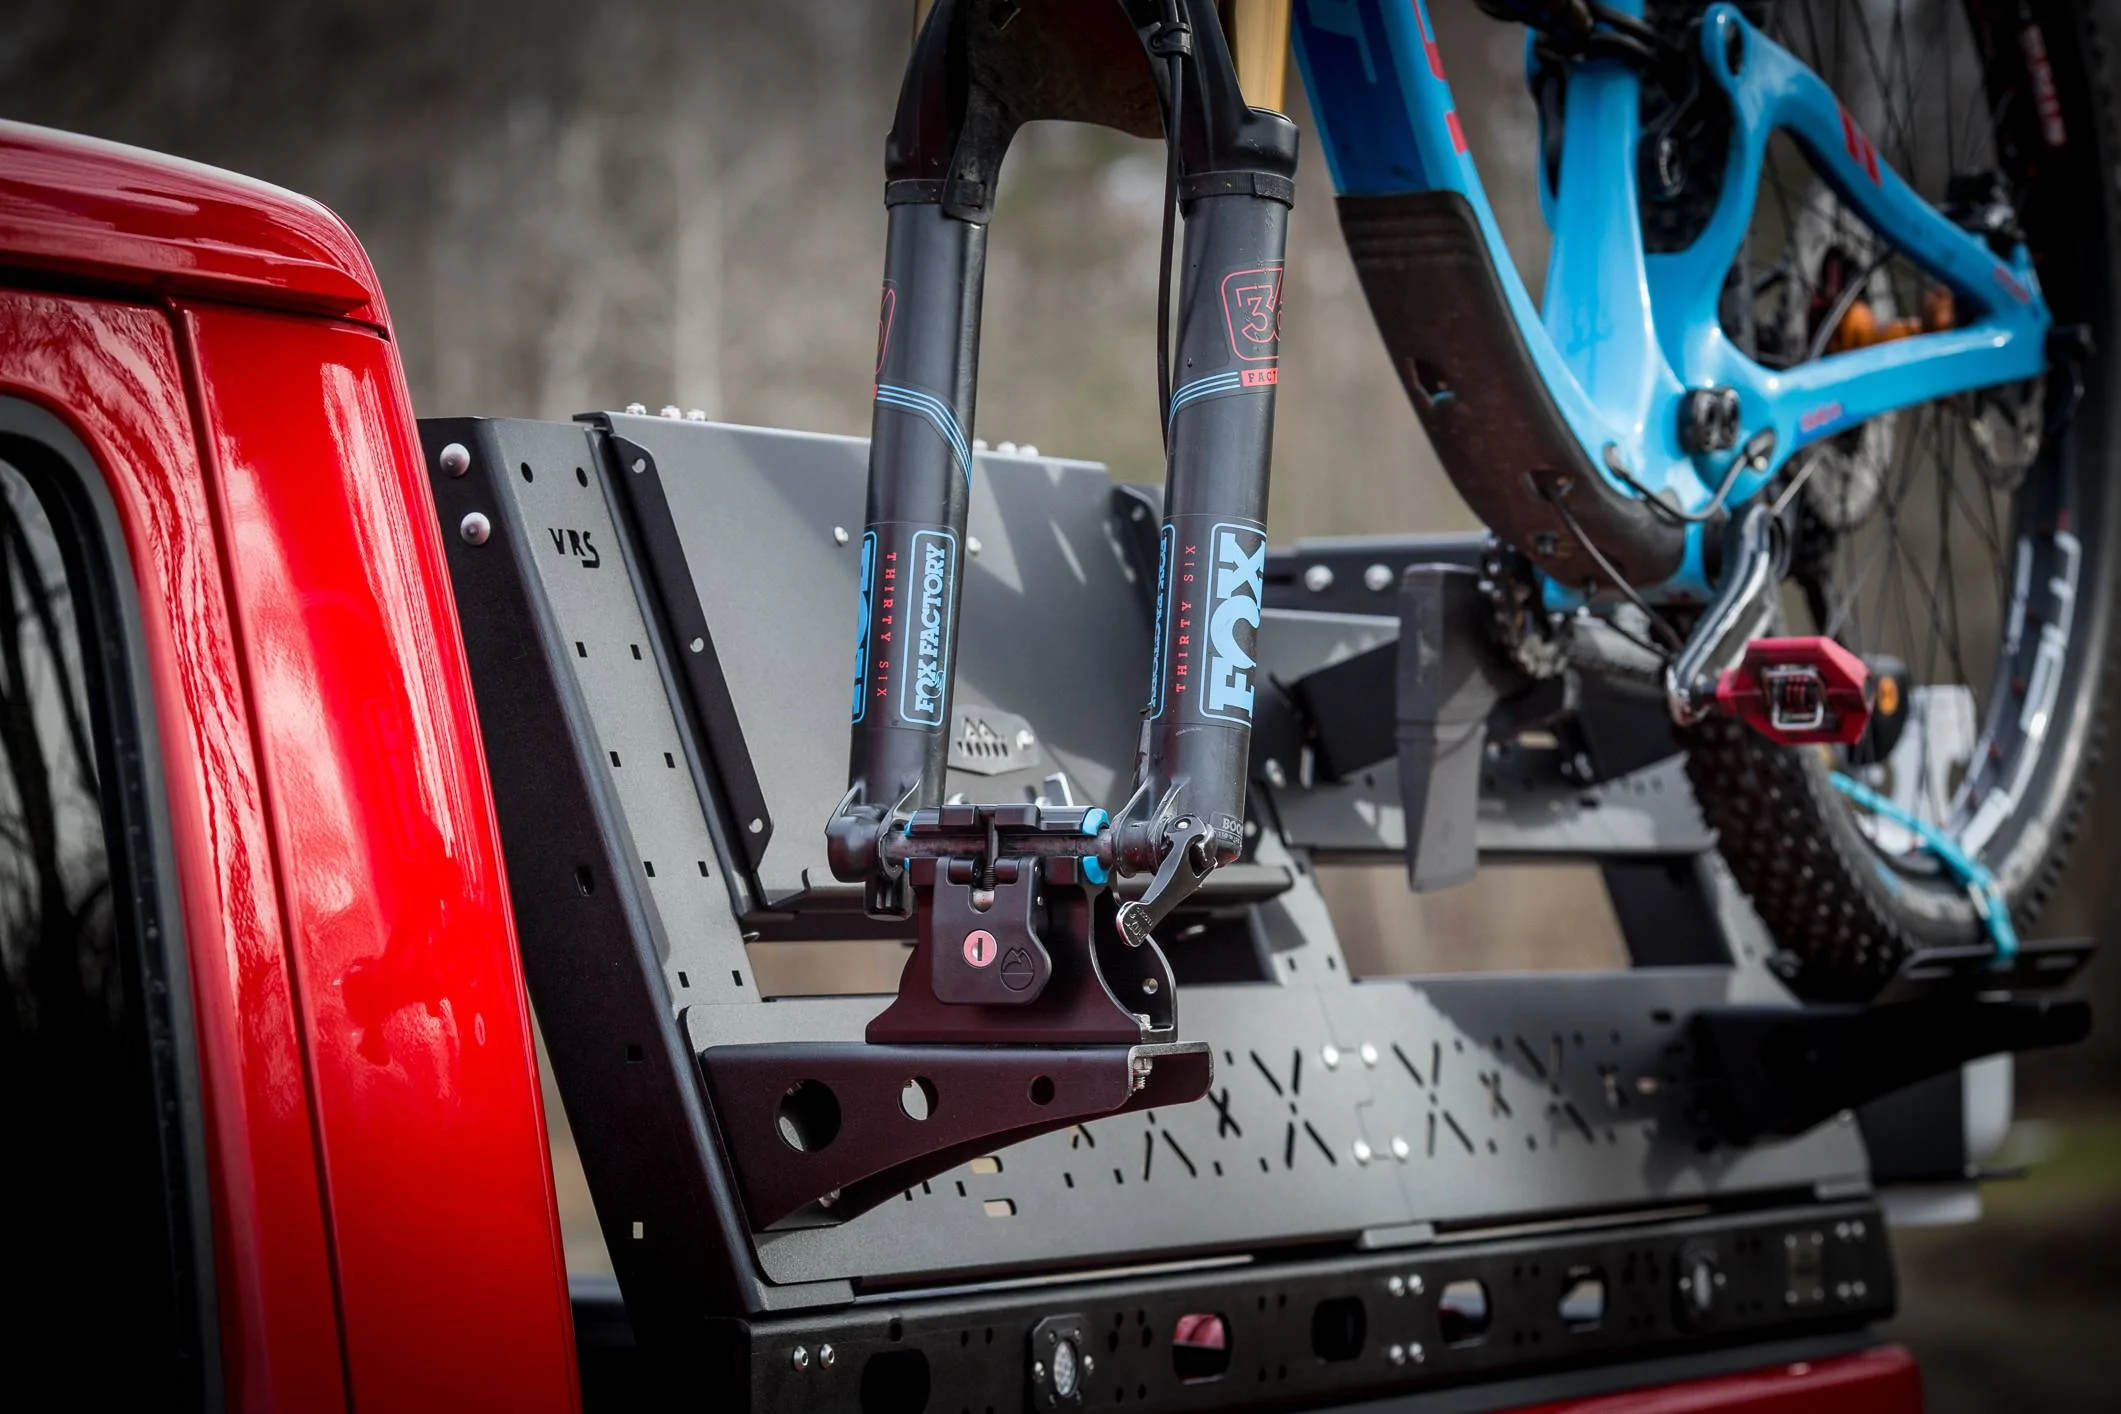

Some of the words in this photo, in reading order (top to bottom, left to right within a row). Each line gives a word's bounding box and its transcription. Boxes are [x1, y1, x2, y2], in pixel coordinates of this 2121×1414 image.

[1236, 284, 1282, 343] 3
[547, 527, 600, 569] VRS
[1183, 545, 1196, 582] SIX
[881, 552, 897, 641] THIRTY
[919, 542, 946, 656] FACTORY
[1209, 532, 1267, 718] FOX
[1176, 601, 1192, 692] THIRTY
[877, 661, 889, 696] SIX
[915, 655, 943, 713] FOX
